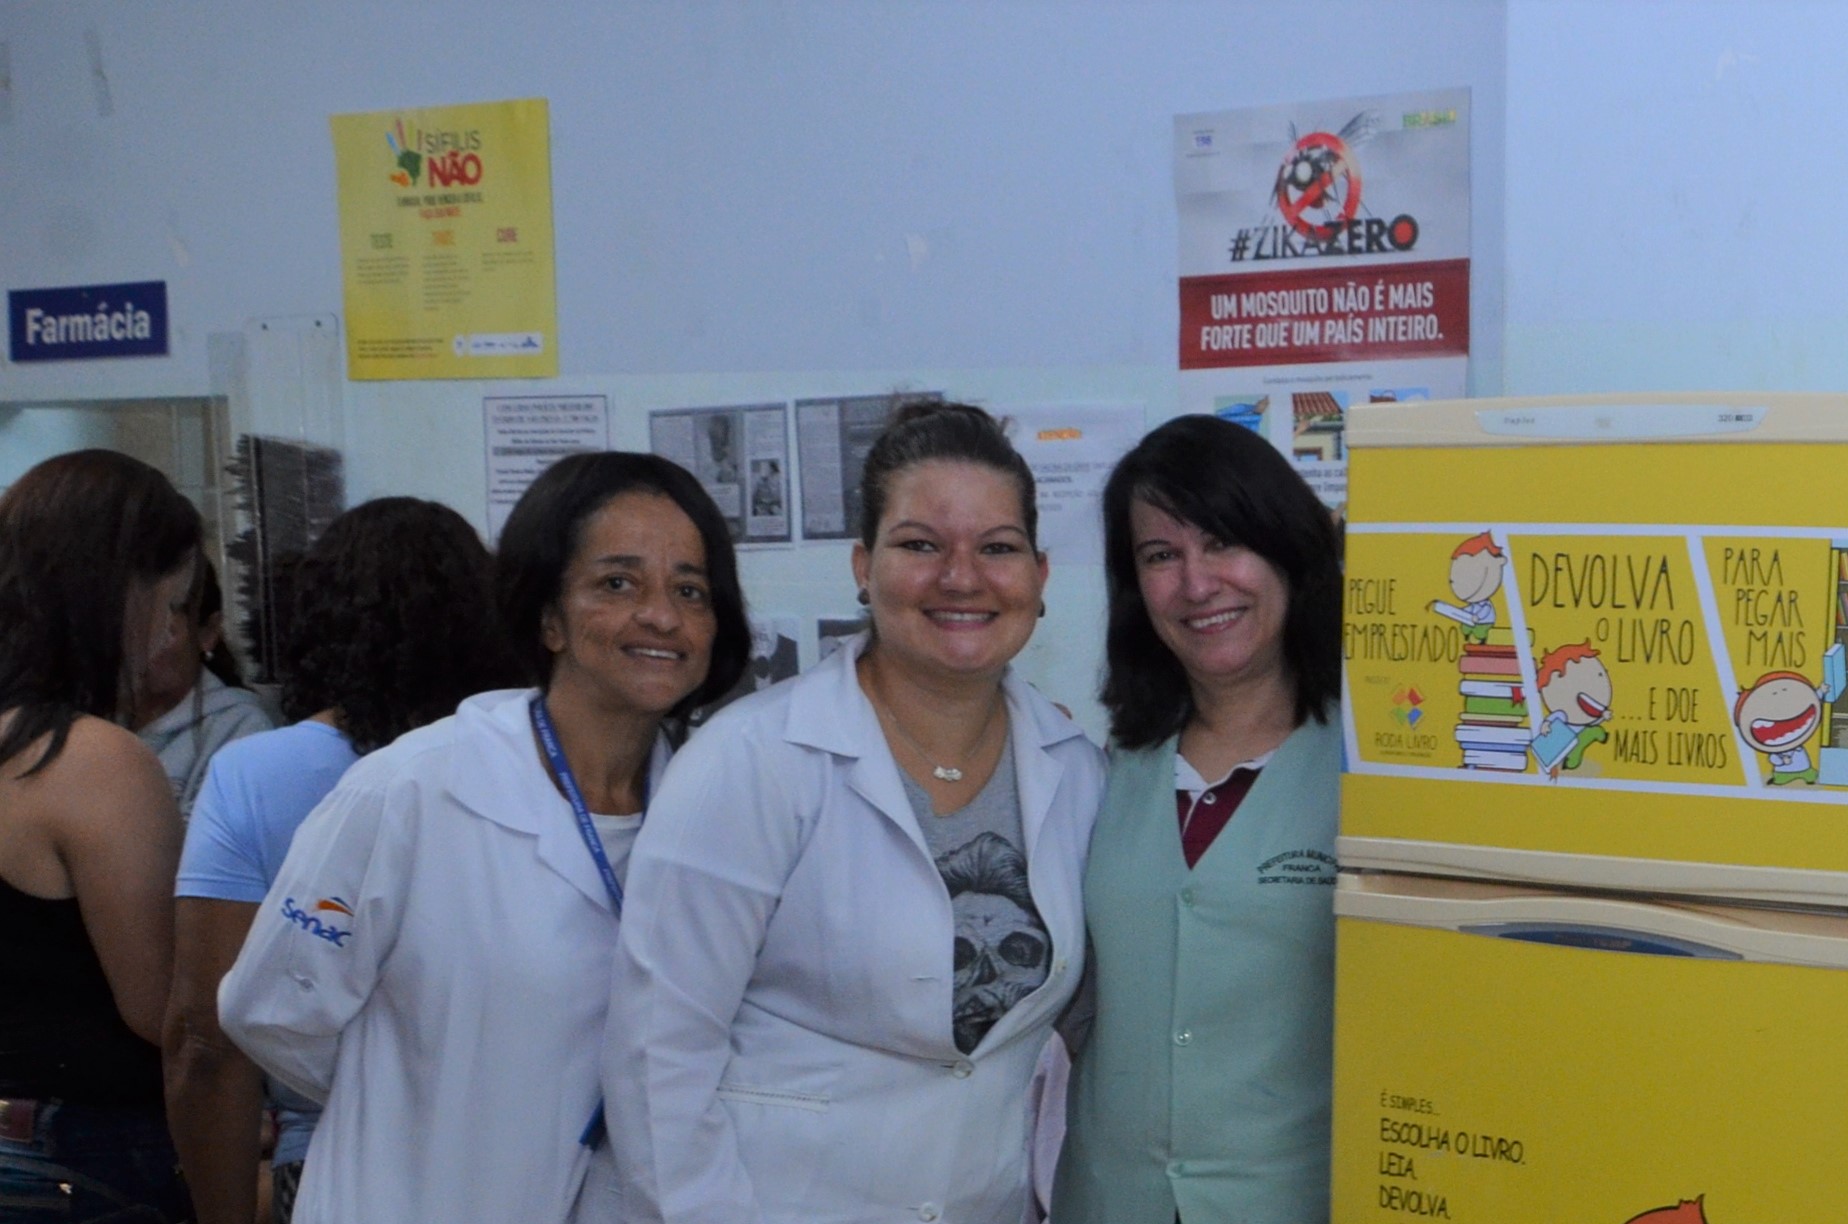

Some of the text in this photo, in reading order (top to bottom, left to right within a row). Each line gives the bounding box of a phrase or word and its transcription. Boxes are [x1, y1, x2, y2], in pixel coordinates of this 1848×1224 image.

[427, 150, 484, 188] NÃO
[1210, 279, 1434, 320] UM MOSQUITO NÃO É MAIS
[25, 301, 151, 346] Farmácia
[1201, 313, 1444, 350] FORTE QUE UM PAÍS INTEIRO.
[1530, 552, 1675, 610] DEVOLVA
[1723, 547, 1784, 587] PARA
[1348, 579, 1398, 615] PEGUE
[1735, 588, 1804, 628] PEGAR
[1343, 622, 1460, 664] EMPRESTADO
[1596, 617, 1695, 666] O LIVRO
[1746, 629, 1807, 669] MAIS
[1650, 686, 1657, 721] E
[1665, 687, 1700, 723] DOE
[1375, 731, 1439, 751] RODA LIVRO
[1613, 729, 1728, 770] MAIS LIVROS
[1281, 863, 1321, 873] FRANCA
[1380, 1117, 1526, 1166] ESCOLHA O LIVRO.
